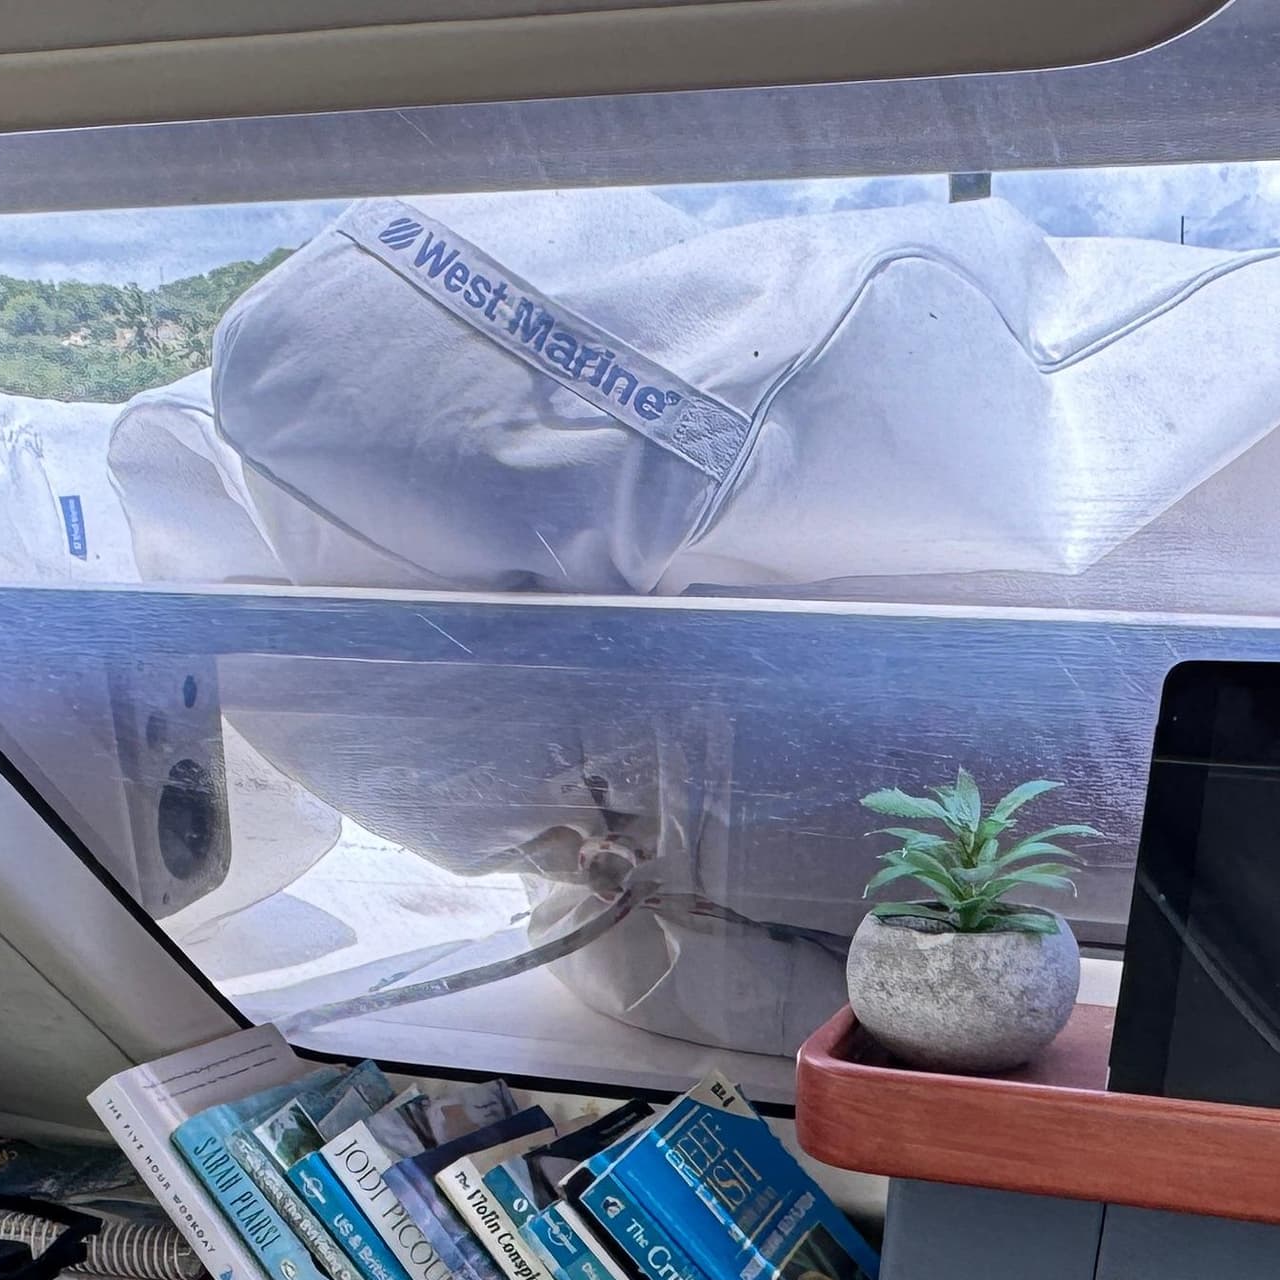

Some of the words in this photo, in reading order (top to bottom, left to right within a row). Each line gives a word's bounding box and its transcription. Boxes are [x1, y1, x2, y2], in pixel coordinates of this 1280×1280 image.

[414, 230, 509, 322] West
[507, 297, 671, 422] Marine
[106, 1099, 123, 1121] THE
[124, 1124, 145, 1151] FIVE
[145, 1154, 172, 1192] HOUR
[173, 1194, 217, 1253] WORKDAY
[195, 1136, 242, 1193] SARAH
[230, 1190, 281, 1251] PEARSE
[334, 1139, 391, 1202] JODI
[334, 1213, 354, 1237] US
[349, 1234, 363, 1250] &
[455, 1171, 470, 1190] The
[467, 1189, 501, 1235] Violin
[626, 1218, 649, 1249] The
